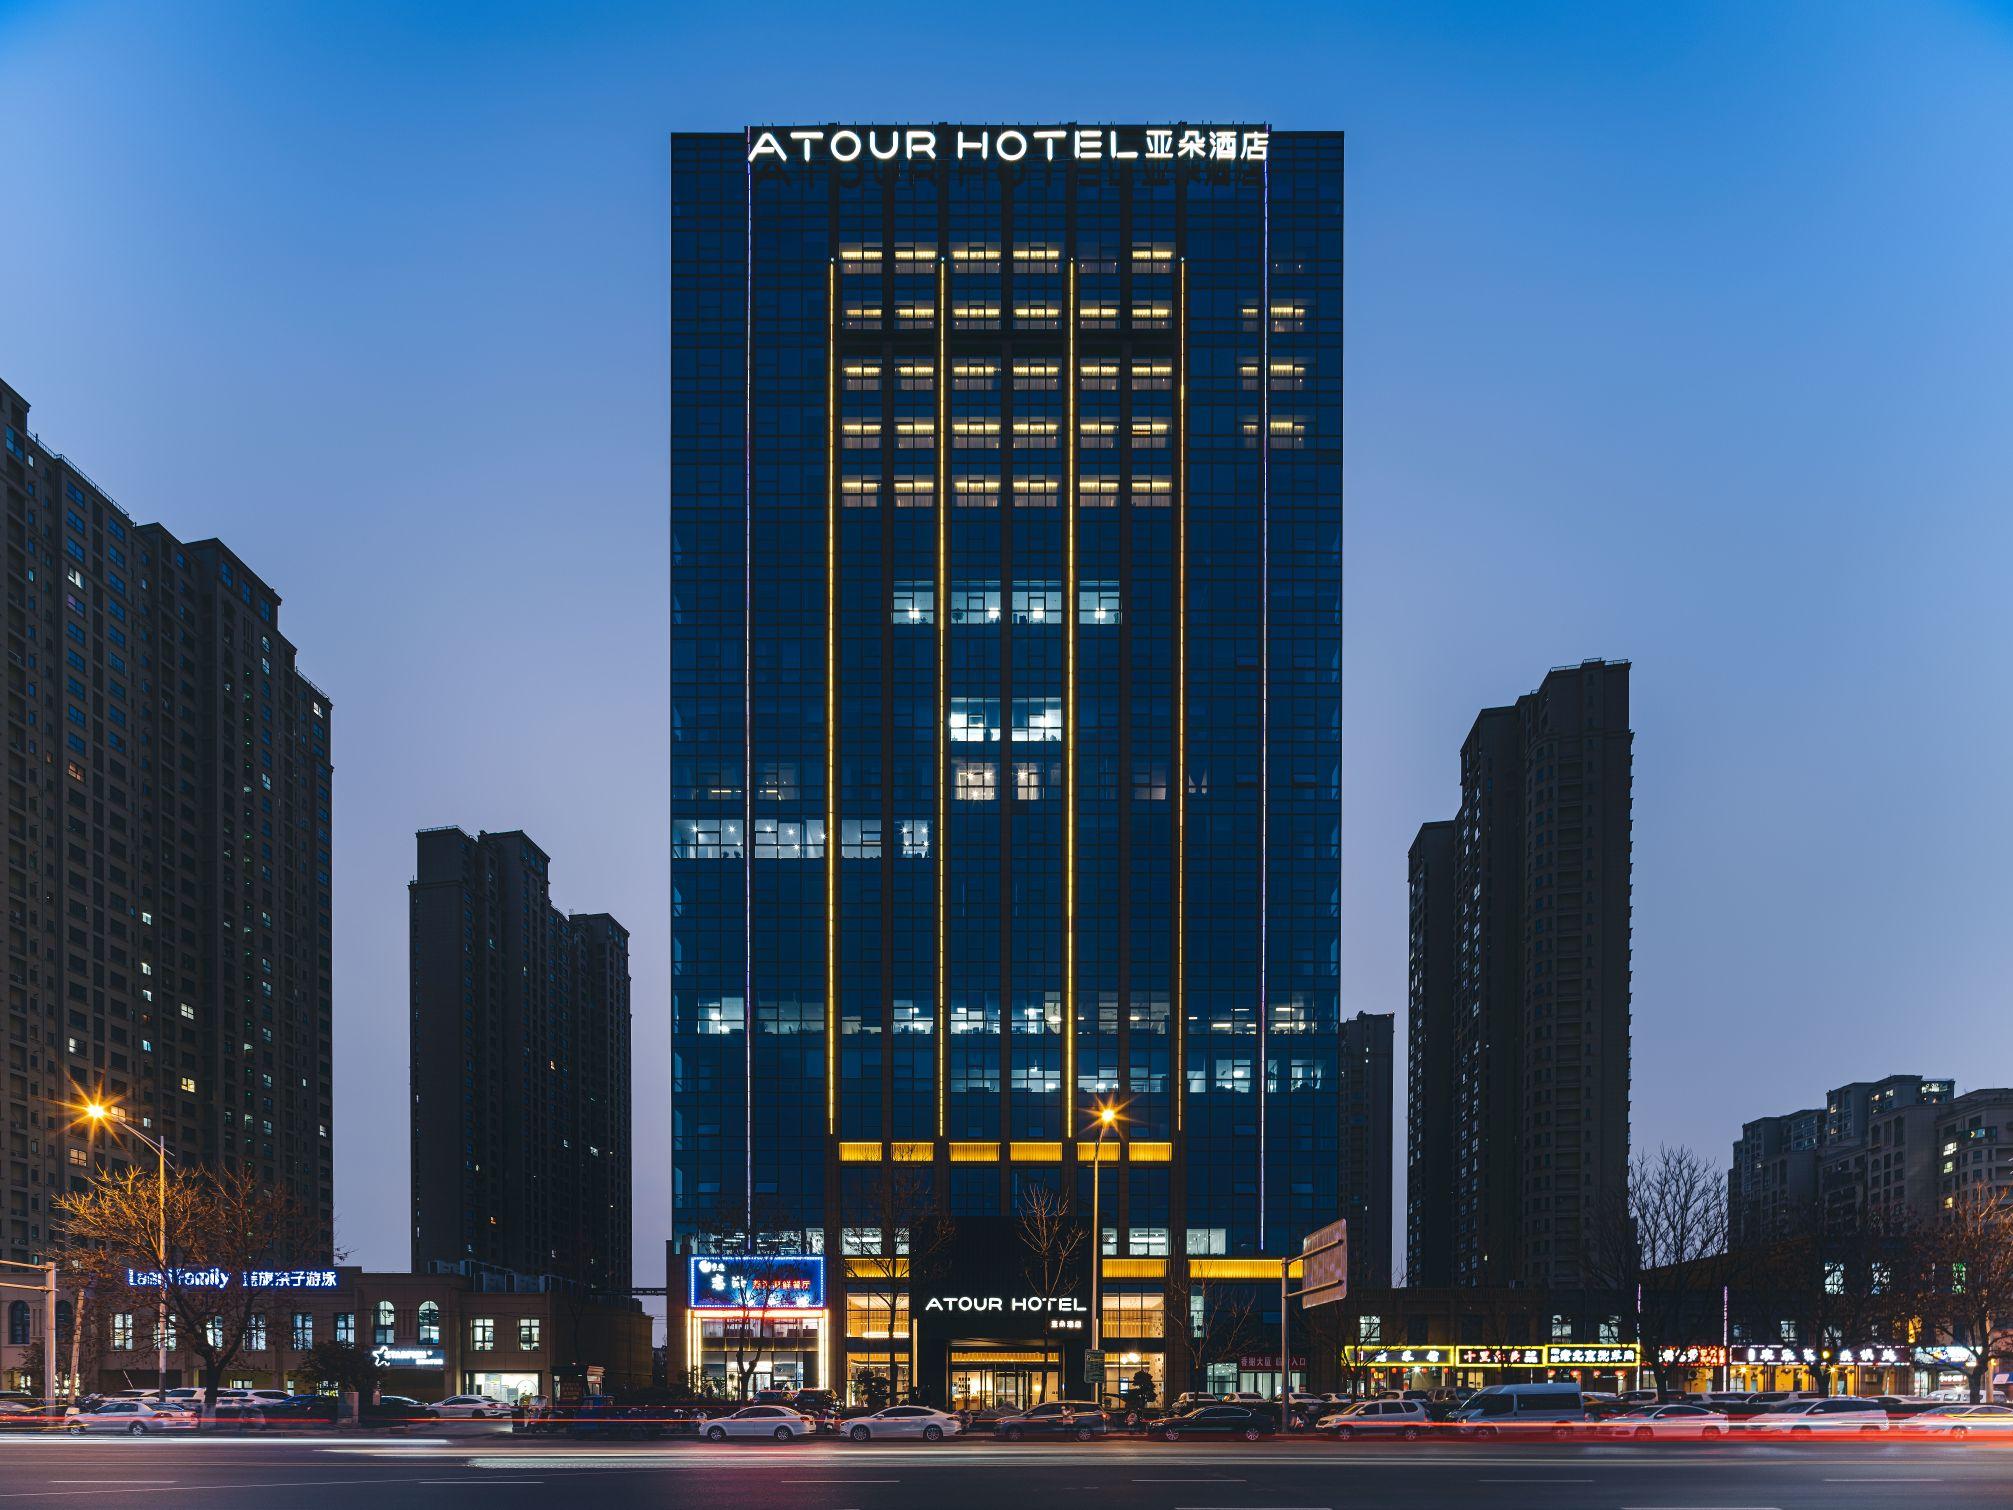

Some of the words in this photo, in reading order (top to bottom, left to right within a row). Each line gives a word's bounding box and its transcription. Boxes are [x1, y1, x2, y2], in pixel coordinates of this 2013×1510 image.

[748, 131, 937, 162] ATOUR
[957, 131, 1140, 162] HOTEL
[1145, 130, 1270, 162] 亚朵酒店
[925, 1296, 1003, 1312] ATOUR
[1012, 1296, 1087, 1312] HOTEL
